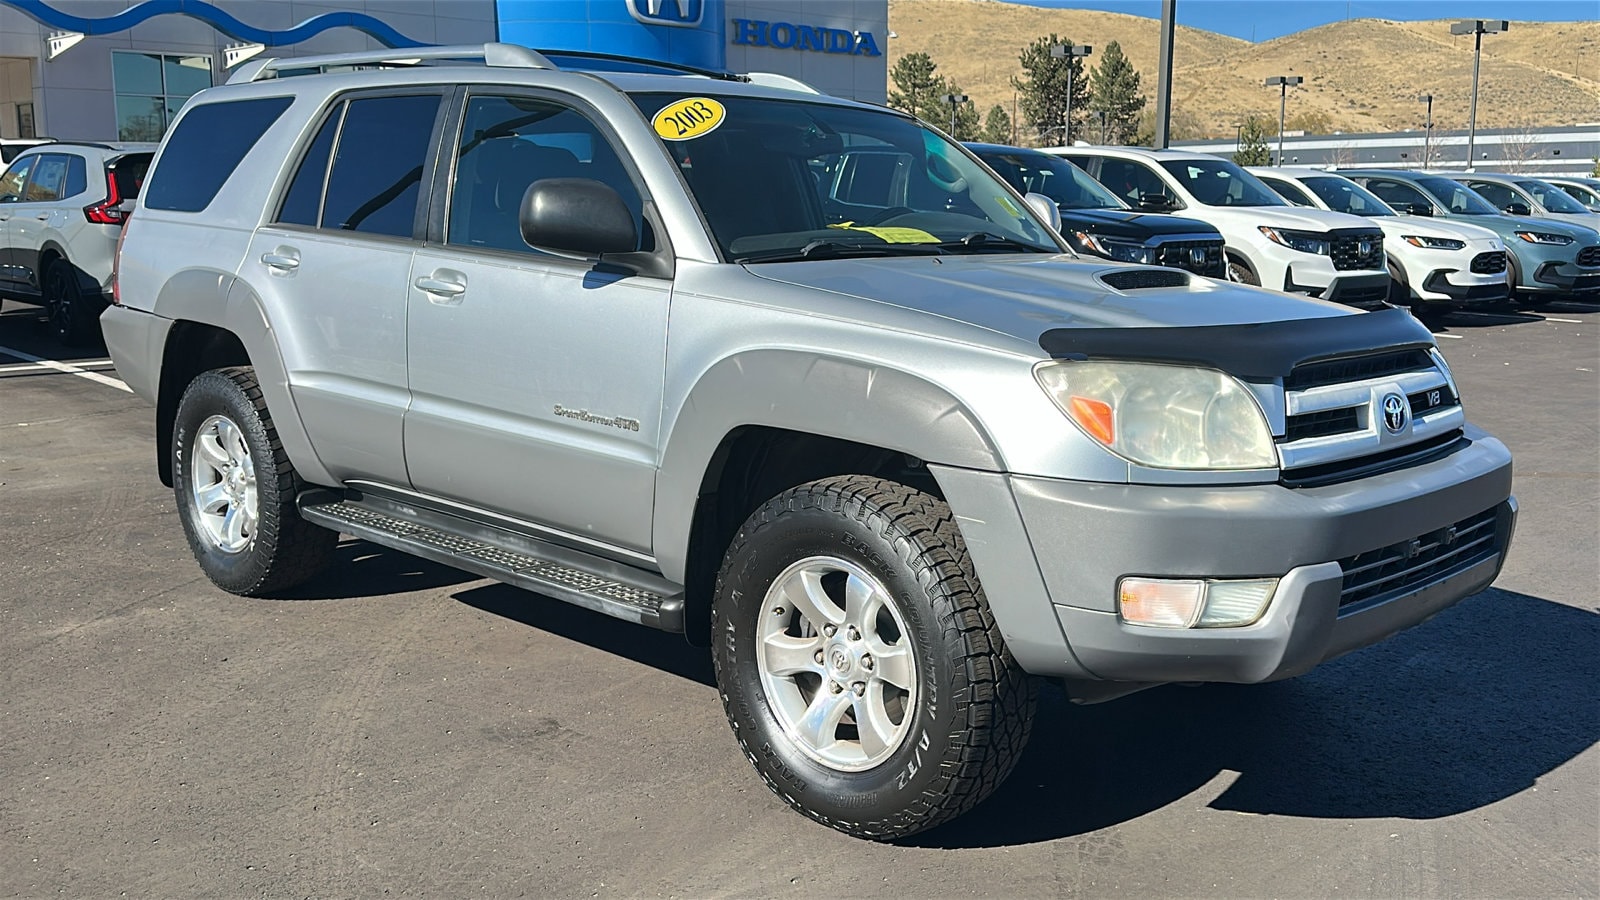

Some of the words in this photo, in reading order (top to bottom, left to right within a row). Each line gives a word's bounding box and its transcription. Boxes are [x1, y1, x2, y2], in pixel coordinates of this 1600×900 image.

[732, 18, 882, 57] HONDA
[664, 101, 714, 136] 2003
[1427, 391, 1441, 407] V8
[613, 416, 640, 432] 4WD
[841, 531, 897, 580] BACK
[895, 728, 930, 790] A/T2
[760, 742, 808, 792] BACK
